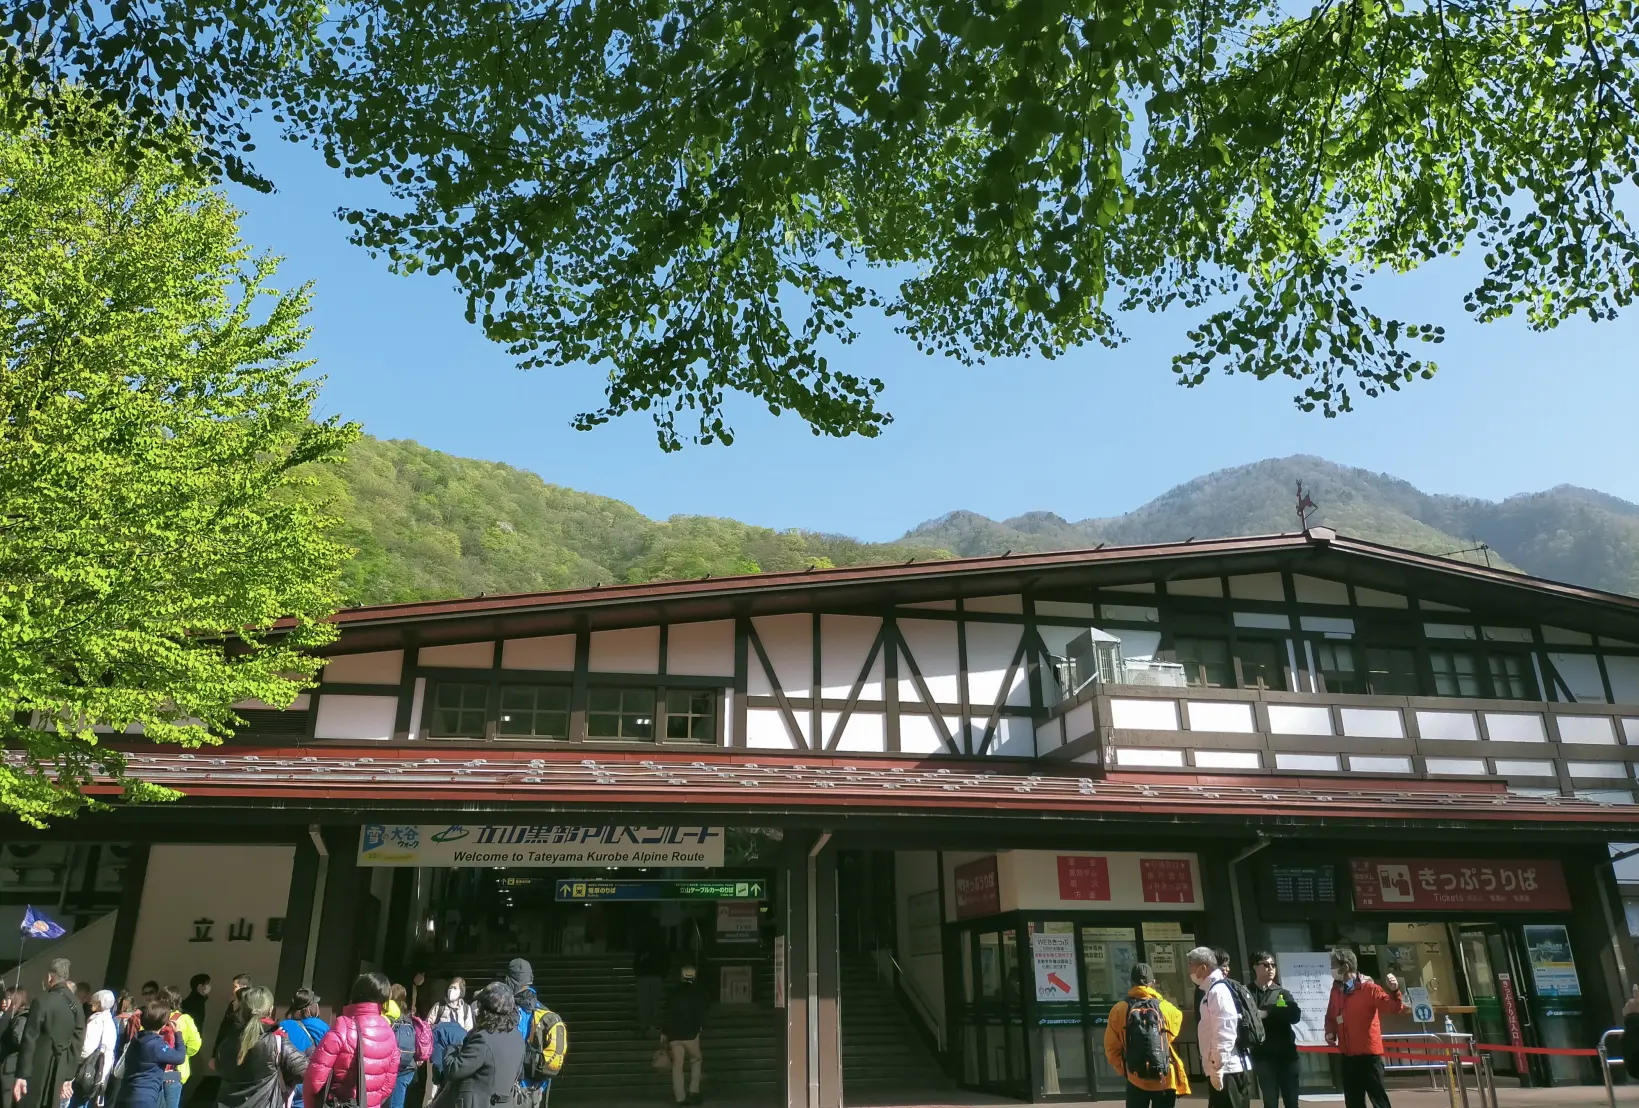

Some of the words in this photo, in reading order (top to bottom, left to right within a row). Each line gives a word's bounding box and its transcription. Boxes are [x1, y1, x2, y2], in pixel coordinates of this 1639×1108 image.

[472, 825, 719, 844] 立山黒部アルペンルート
[453, 851, 509, 862] Welcome
[511, 851, 524, 862] to
[528, 851, 583, 864] Tateyama
[586, 851, 629, 862] Kurobe
[631, 851, 668, 864] Alpine
[671, 851, 705, 862] Route
[1417, 867, 1539, 891] きっぷうりば
[1433, 893, 1464, 902] Tickets
[1502, 980, 1519, 1039] きっぷうりば入口
